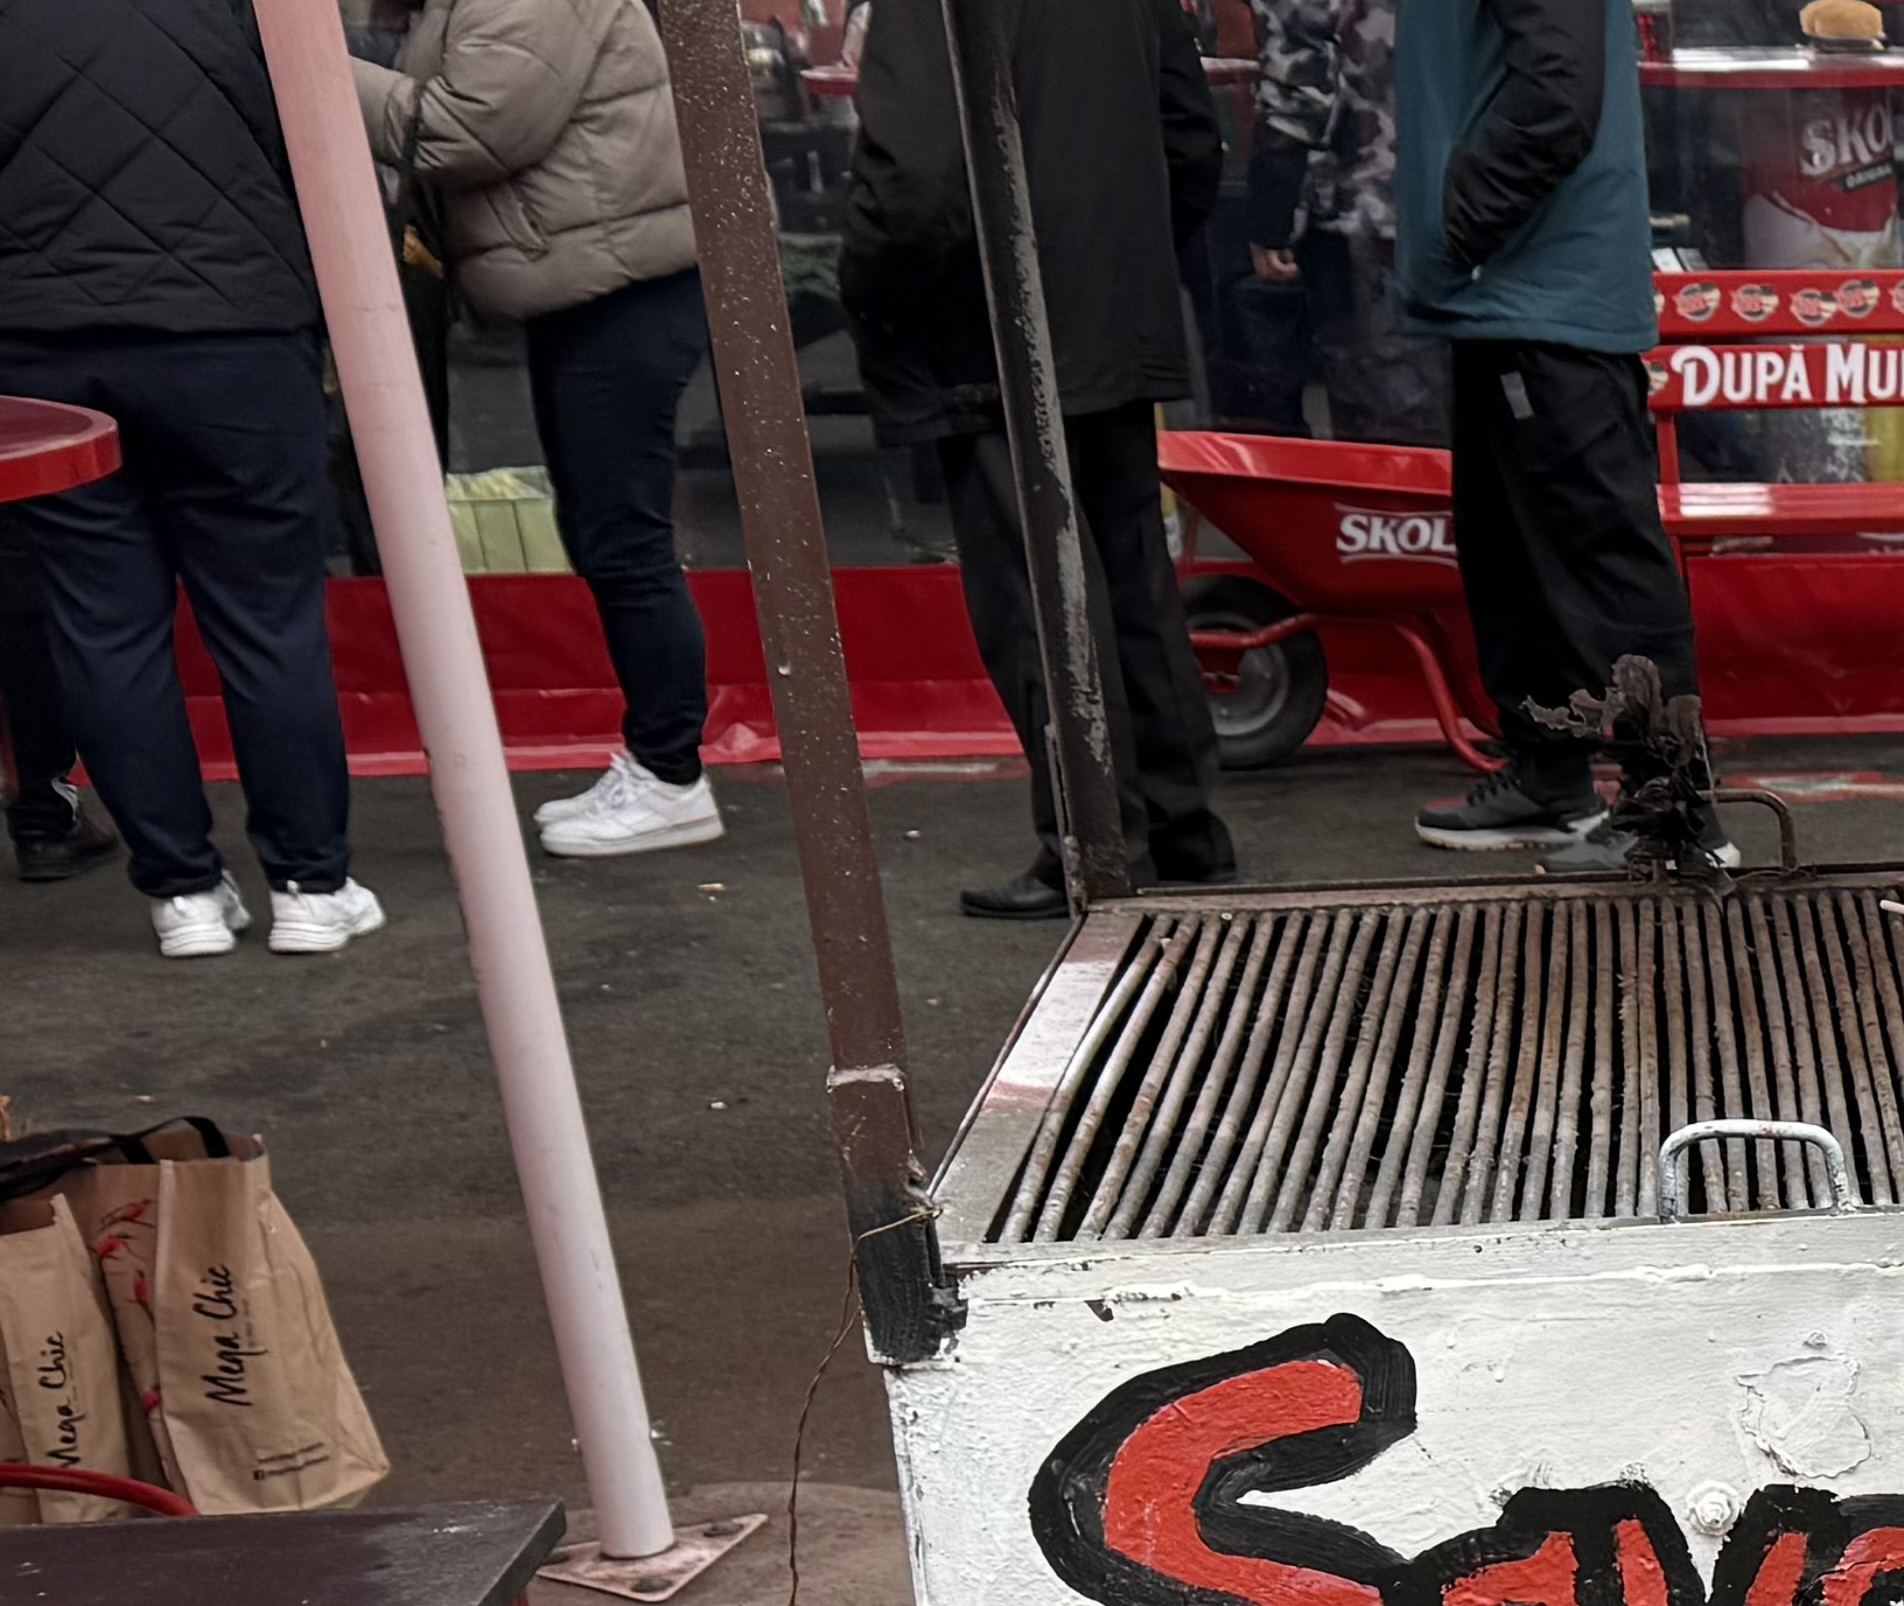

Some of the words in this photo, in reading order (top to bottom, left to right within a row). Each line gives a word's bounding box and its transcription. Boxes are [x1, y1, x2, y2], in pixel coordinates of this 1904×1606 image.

[1799, 104, 1893, 176] SKO
[1670, 344, 1811, 406] DUPĂ
[1336, 514, 1457, 554] SKOL
[192, 1264, 233, 1322] Chic
[38, 1330, 67, 1390] Chic
[204, 1332, 268, 1407] Mega
